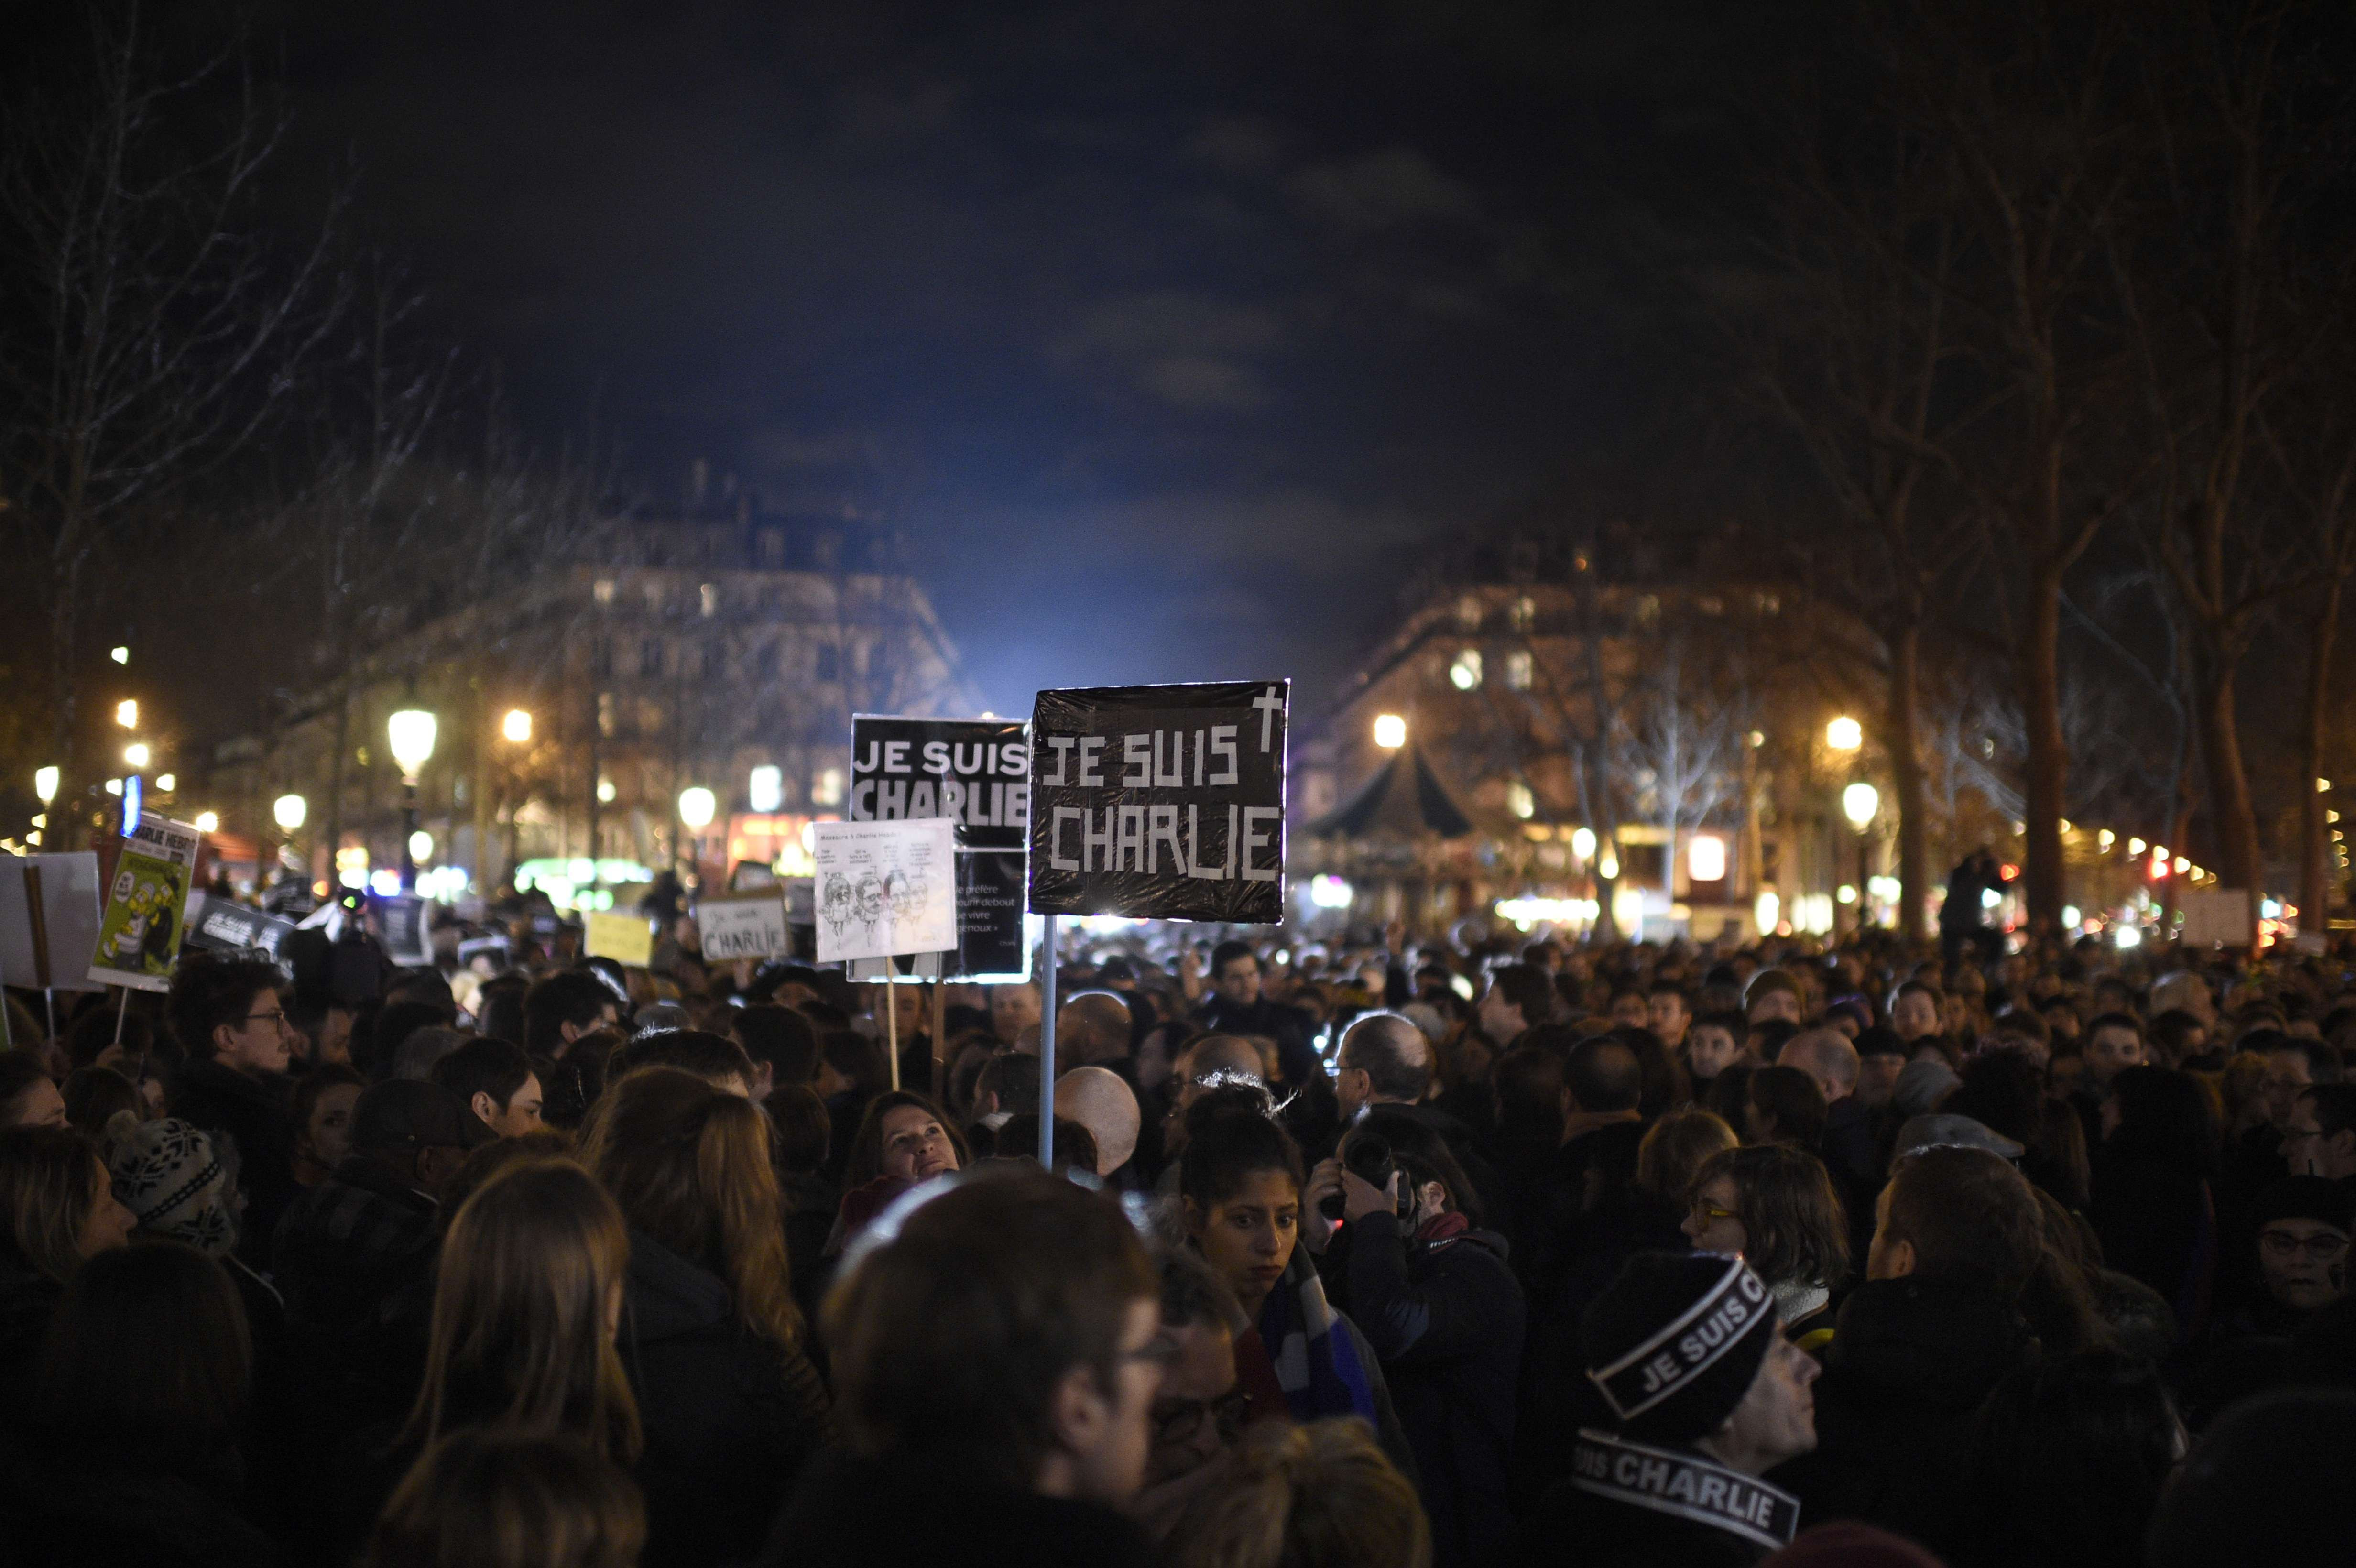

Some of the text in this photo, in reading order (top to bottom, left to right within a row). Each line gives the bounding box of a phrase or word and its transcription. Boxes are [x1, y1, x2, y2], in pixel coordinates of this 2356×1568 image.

[853, 741, 1028, 775] JE SUIS
[1043, 725, 1238, 787] JE SUIS
[852, 779, 1027, 827] CHARLIE
[1051, 804, 1279, 881] CHARLIE
[956, 897, 1014, 906] ourir debout
[968, 911, 990, 919] vivre
[1643, 1353, 1682, 1392] JE
[1680, 1296, 1748, 1362] SUIS
[1615, 1454, 1774, 1528] CHARLIE
